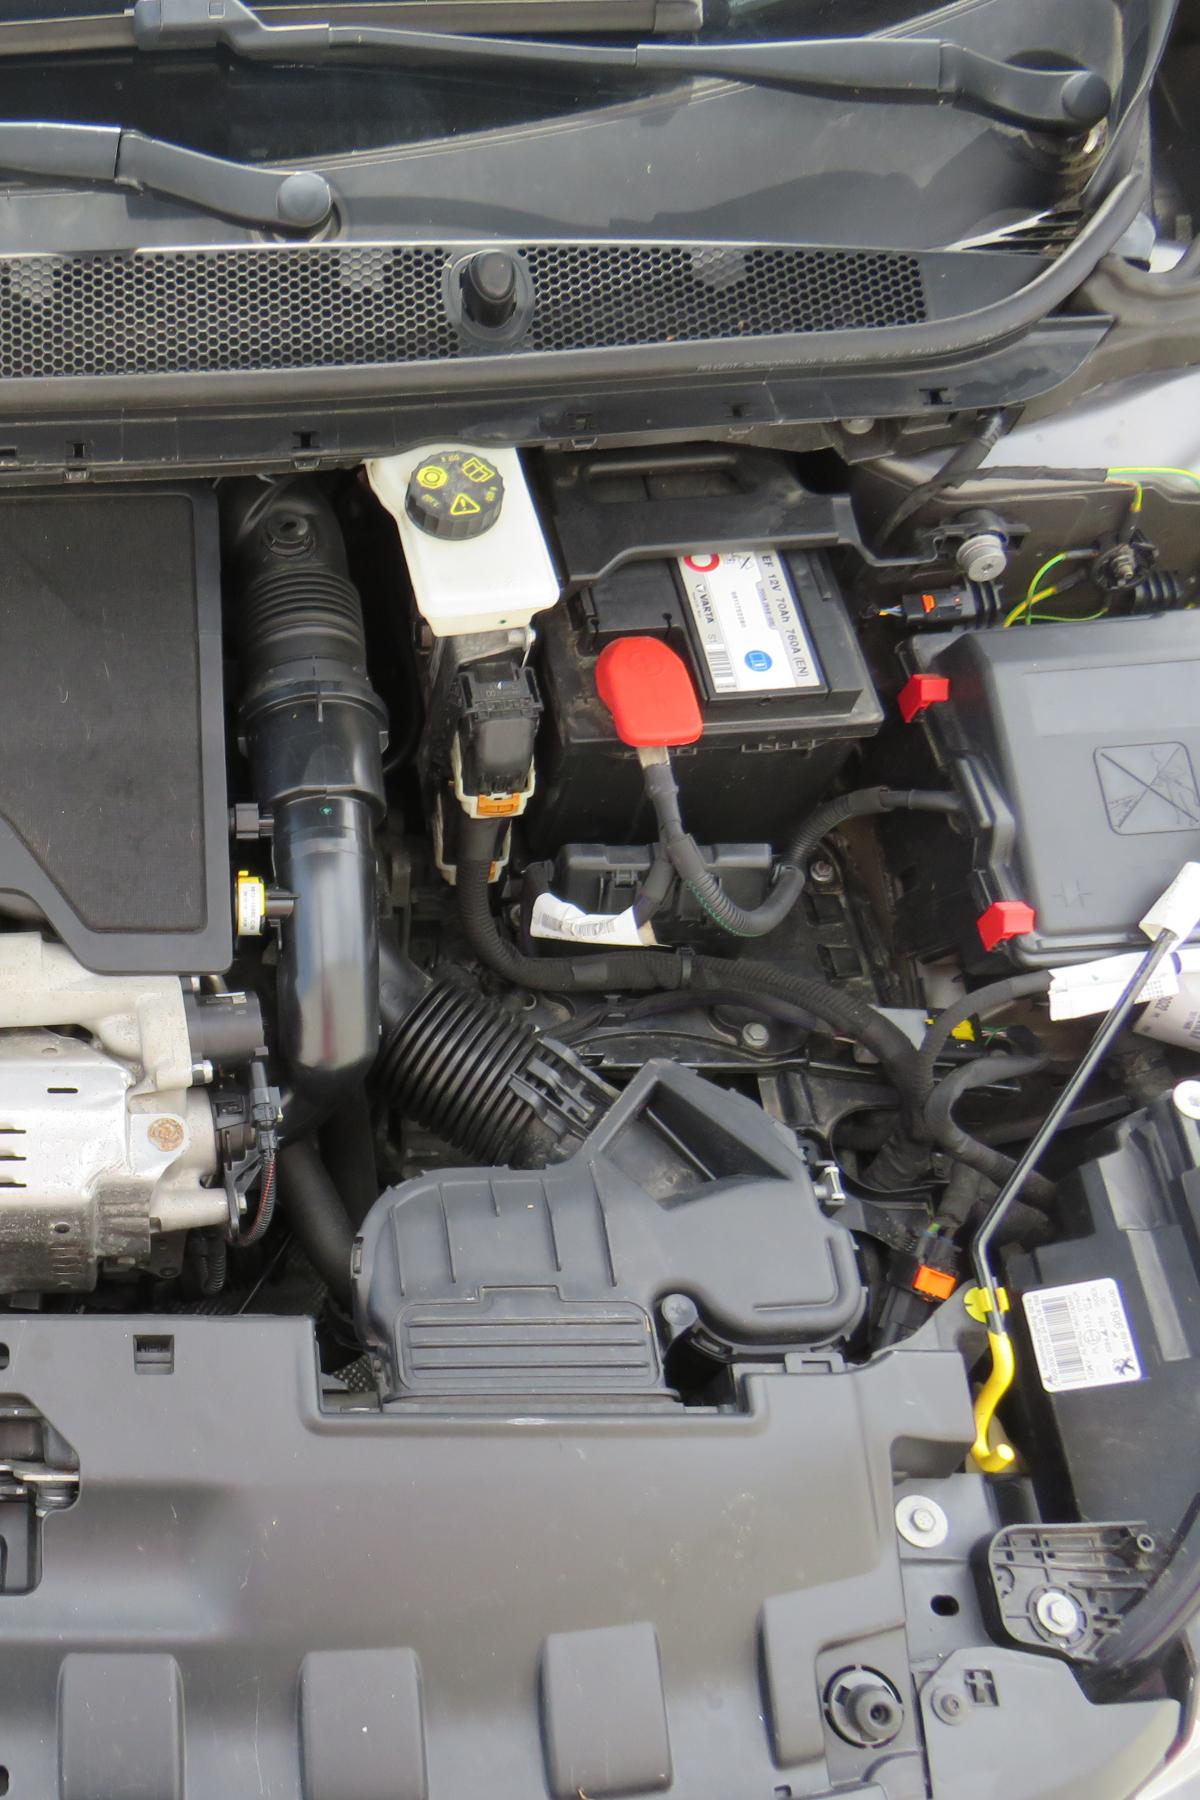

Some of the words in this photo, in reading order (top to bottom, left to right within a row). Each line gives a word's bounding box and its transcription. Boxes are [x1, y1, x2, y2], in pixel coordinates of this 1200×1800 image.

[700, 593, 714, 623] VARTA
[768, 574, 782, 591] 12V
[775, 598, 790, 623] 70Ah
[786, 629, 801, 654] 760A
